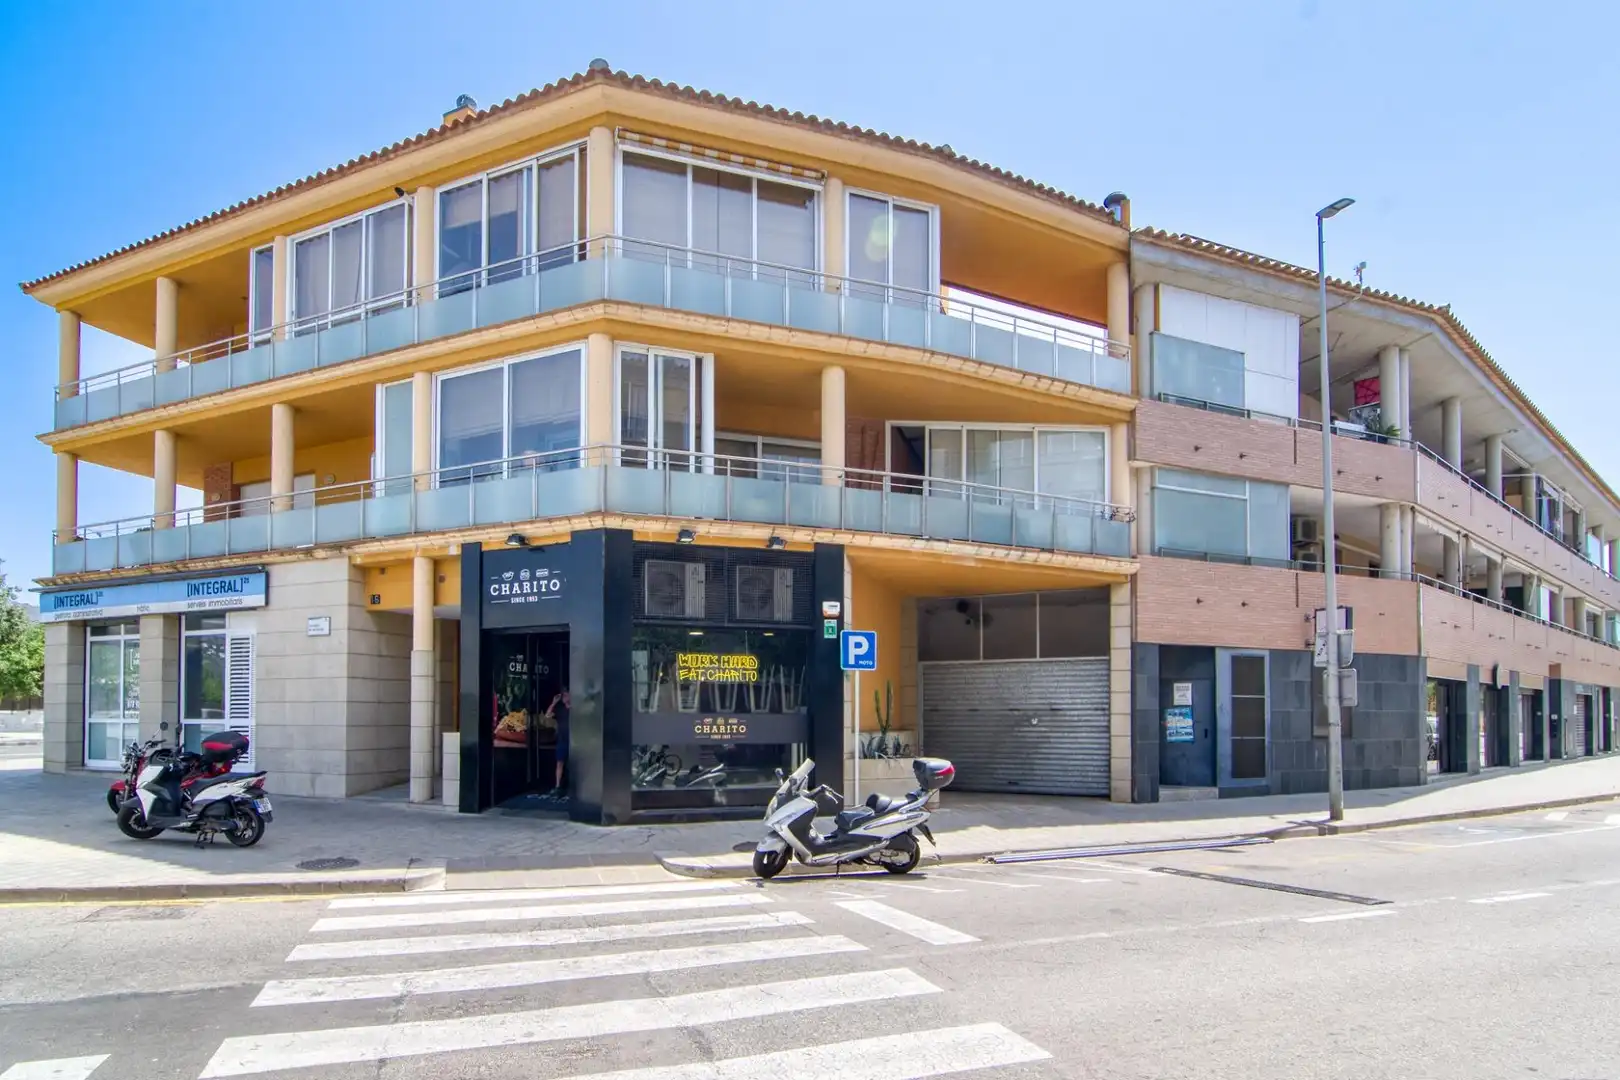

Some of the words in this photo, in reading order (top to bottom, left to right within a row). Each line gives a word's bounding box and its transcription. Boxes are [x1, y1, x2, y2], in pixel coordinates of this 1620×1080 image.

[490, 579, 560, 596] CHARITO
[848, 635, 869, 665] P
[678, 653, 718, 668] WORK
[720, 655, 758, 669] HARD
[707, 669, 757, 682] CHARITO
[694, 725, 746, 733] CHARITO
